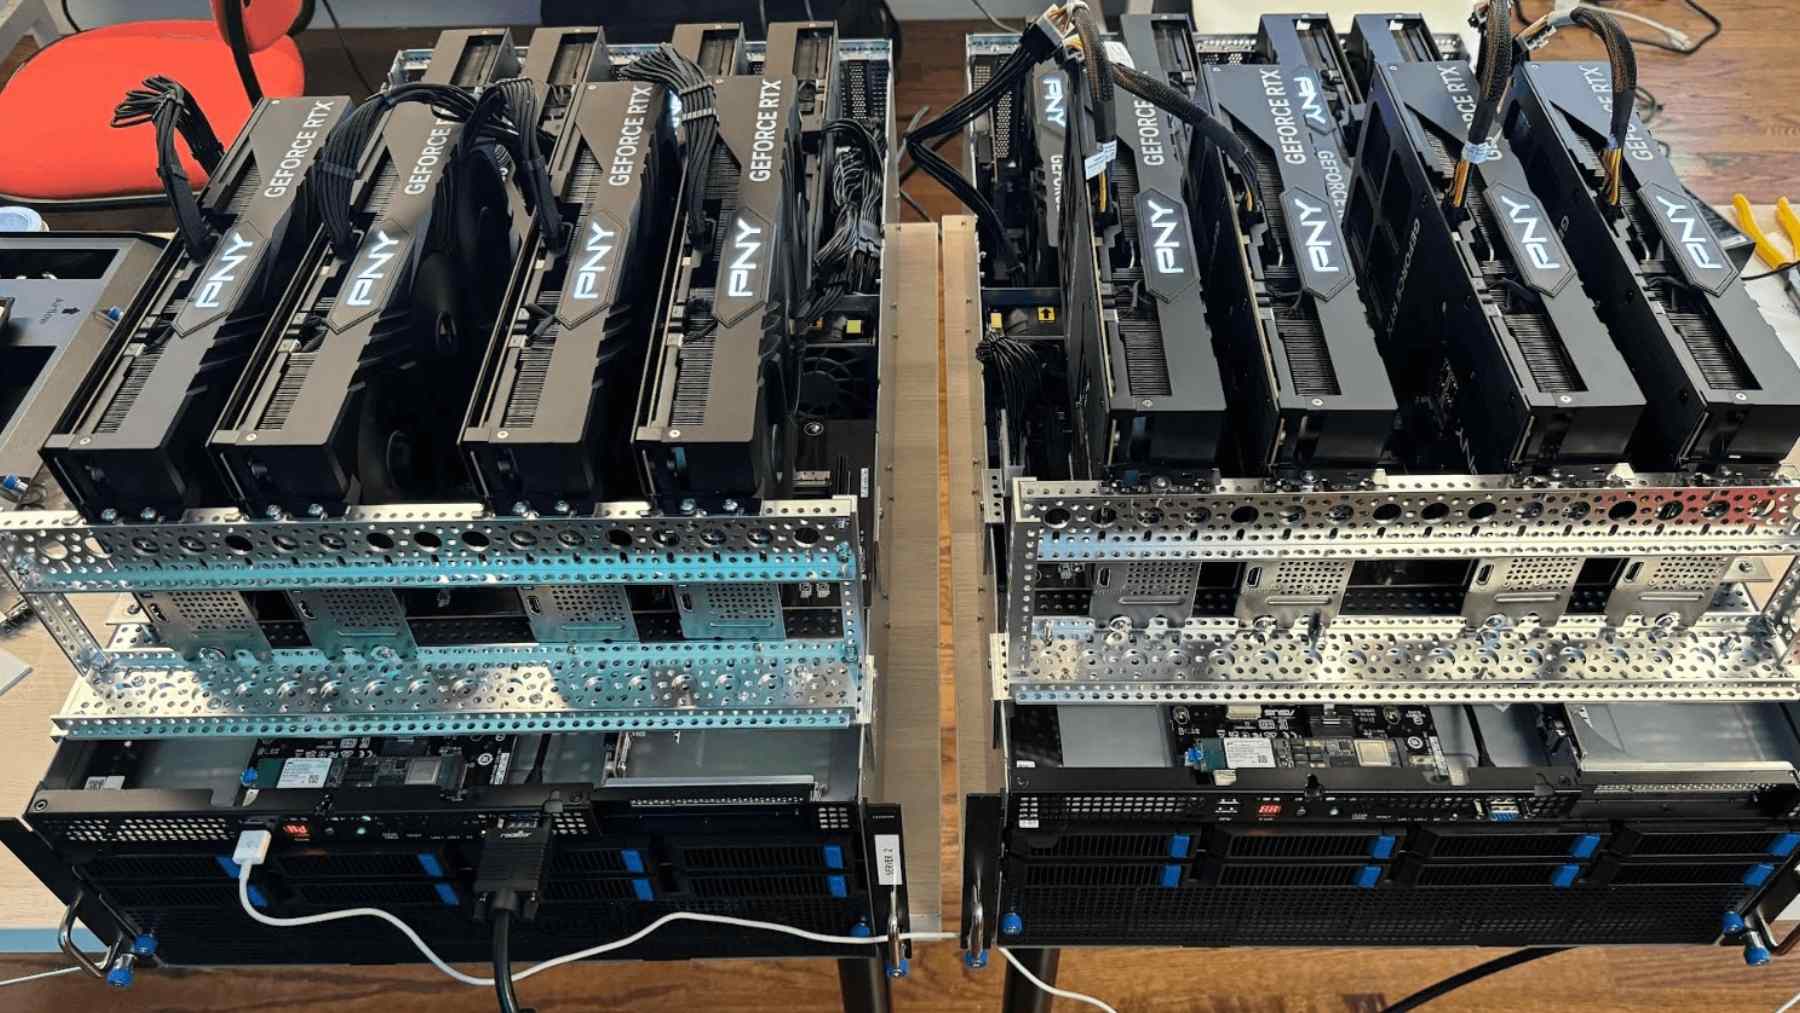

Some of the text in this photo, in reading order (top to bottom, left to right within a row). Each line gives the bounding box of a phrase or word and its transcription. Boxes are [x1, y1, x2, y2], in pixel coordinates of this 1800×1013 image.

[1043, 78, 1067, 128] PNY
[1259, 68, 1307, 164] GEFORCE RTX
[1294, 76, 1327, 125] PNY
[1436, 65, 1469, 92] RTX
[1579, 65, 1612, 92] RTX
[263, 100, 335, 198] GEFORCE RTX
[404, 127, 452, 195] GEFORCE
[608, 84, 653, 187] GEFORCE RTX
[749, 79, 782, 182] GEFORCE RTX
[1133, 99, 1165, 166] GEFORCE
[346, 230, 400, 307] PNY
[573, 221, 615, 300] PNY
[728, 217, 762, 297] PNY
[1147, 200, 1184, 274] PNY
[1294, 198, 1340, 273] PNY
[1501, 195, 1560, 270] PNY
[1655, 194, 1723, 269] PNY
[195, 231, 254, 308] PNY
